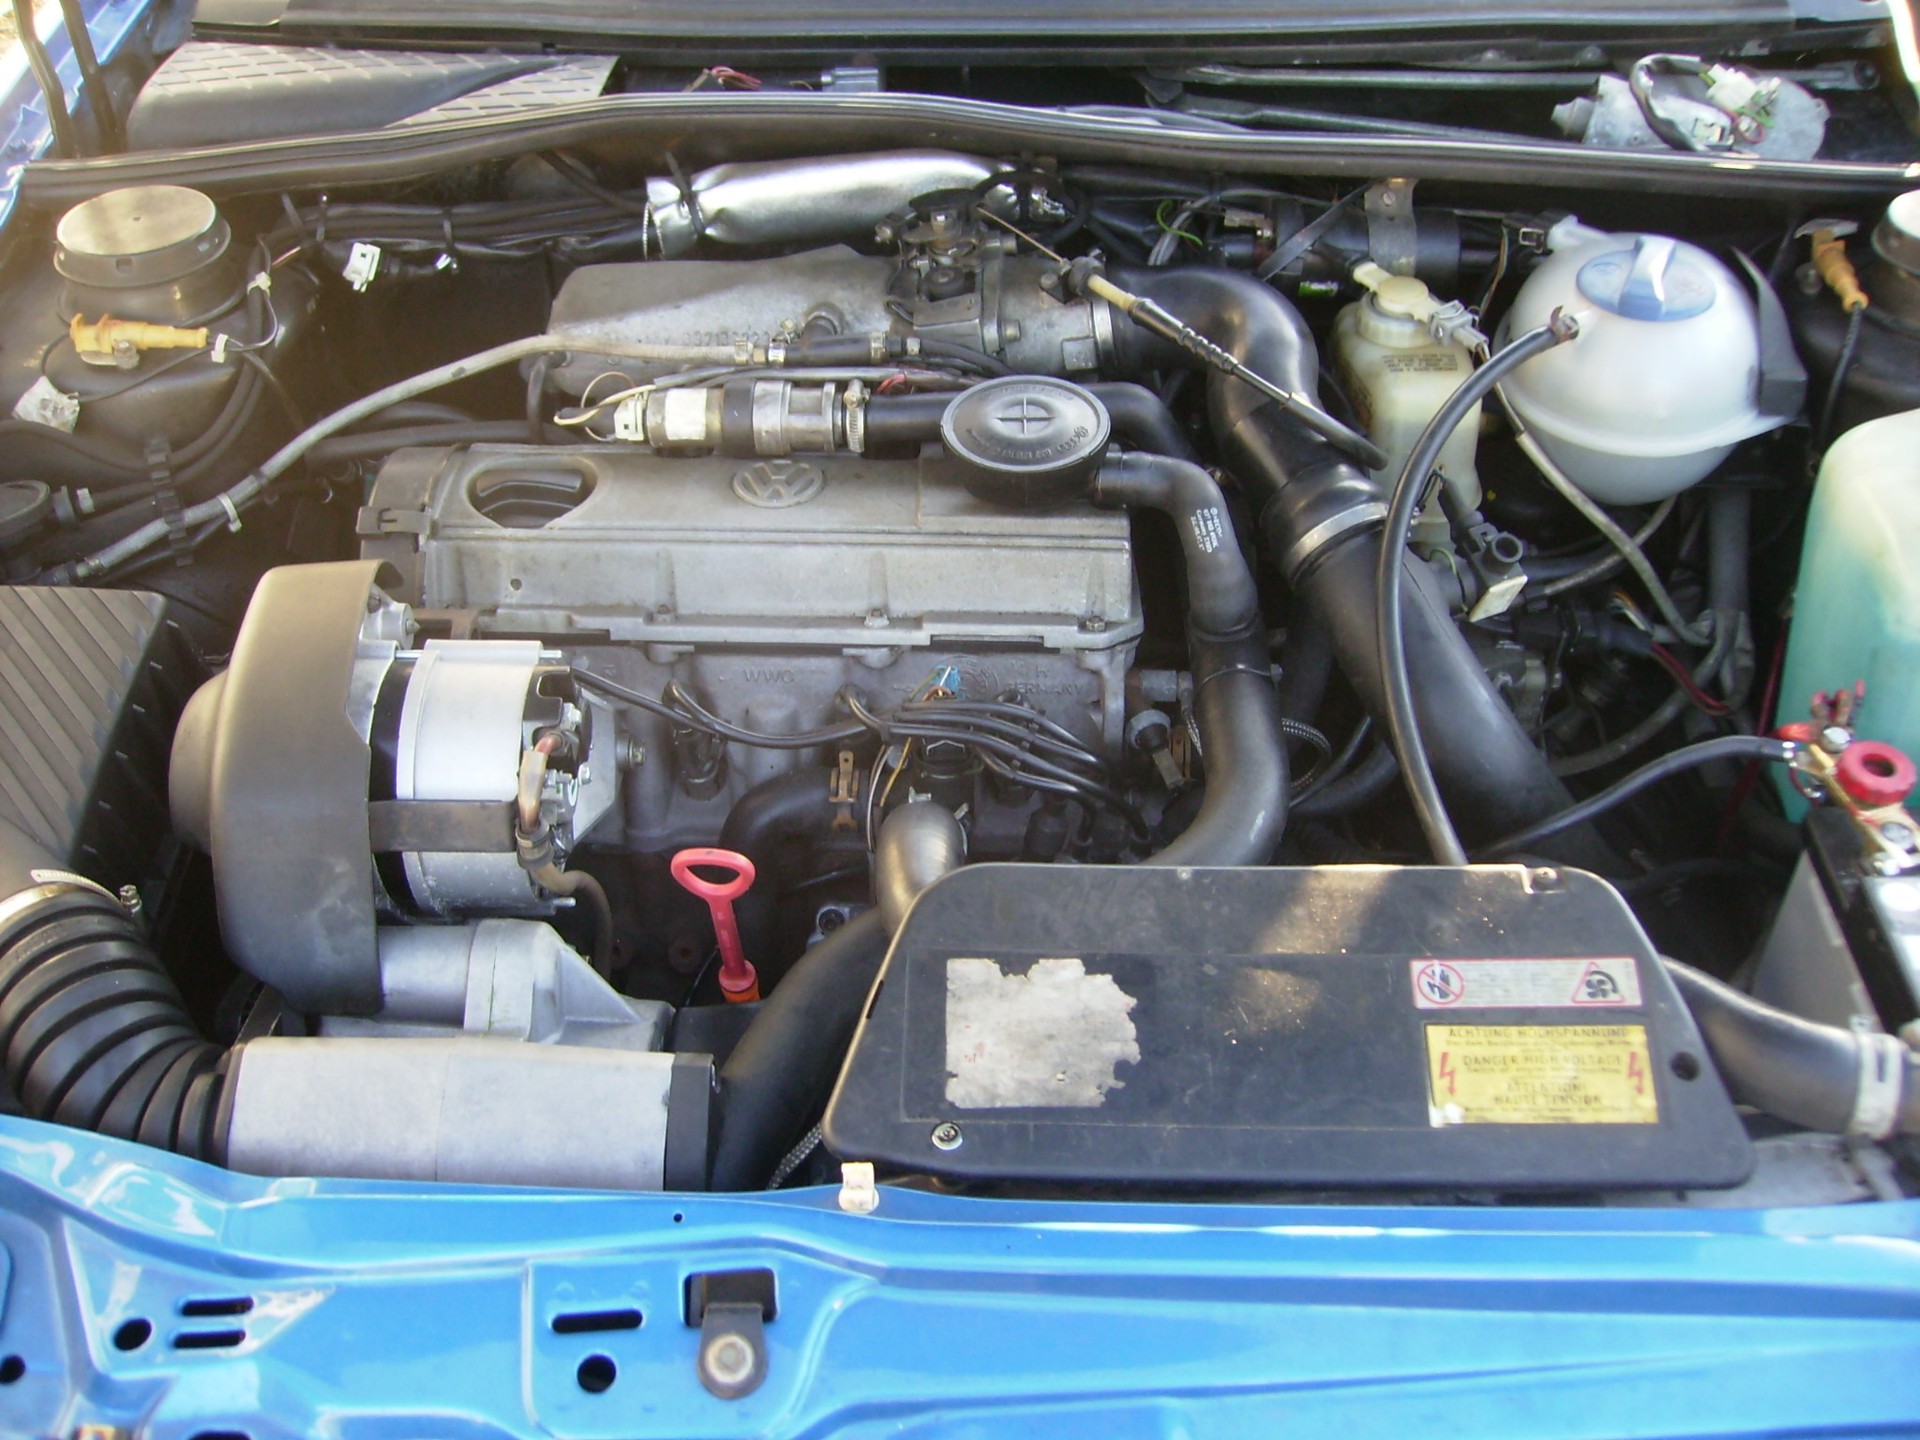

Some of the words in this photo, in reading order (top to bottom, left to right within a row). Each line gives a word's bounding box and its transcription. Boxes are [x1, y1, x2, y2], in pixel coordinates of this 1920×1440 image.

[732, 459, 823, 508] VW
[1449, 1028, 1512, 1038] ACHTUNG
[1463, 1055, 1519, 1066] DANGER
[1524, 1055, 1558, 1065] HIGH
